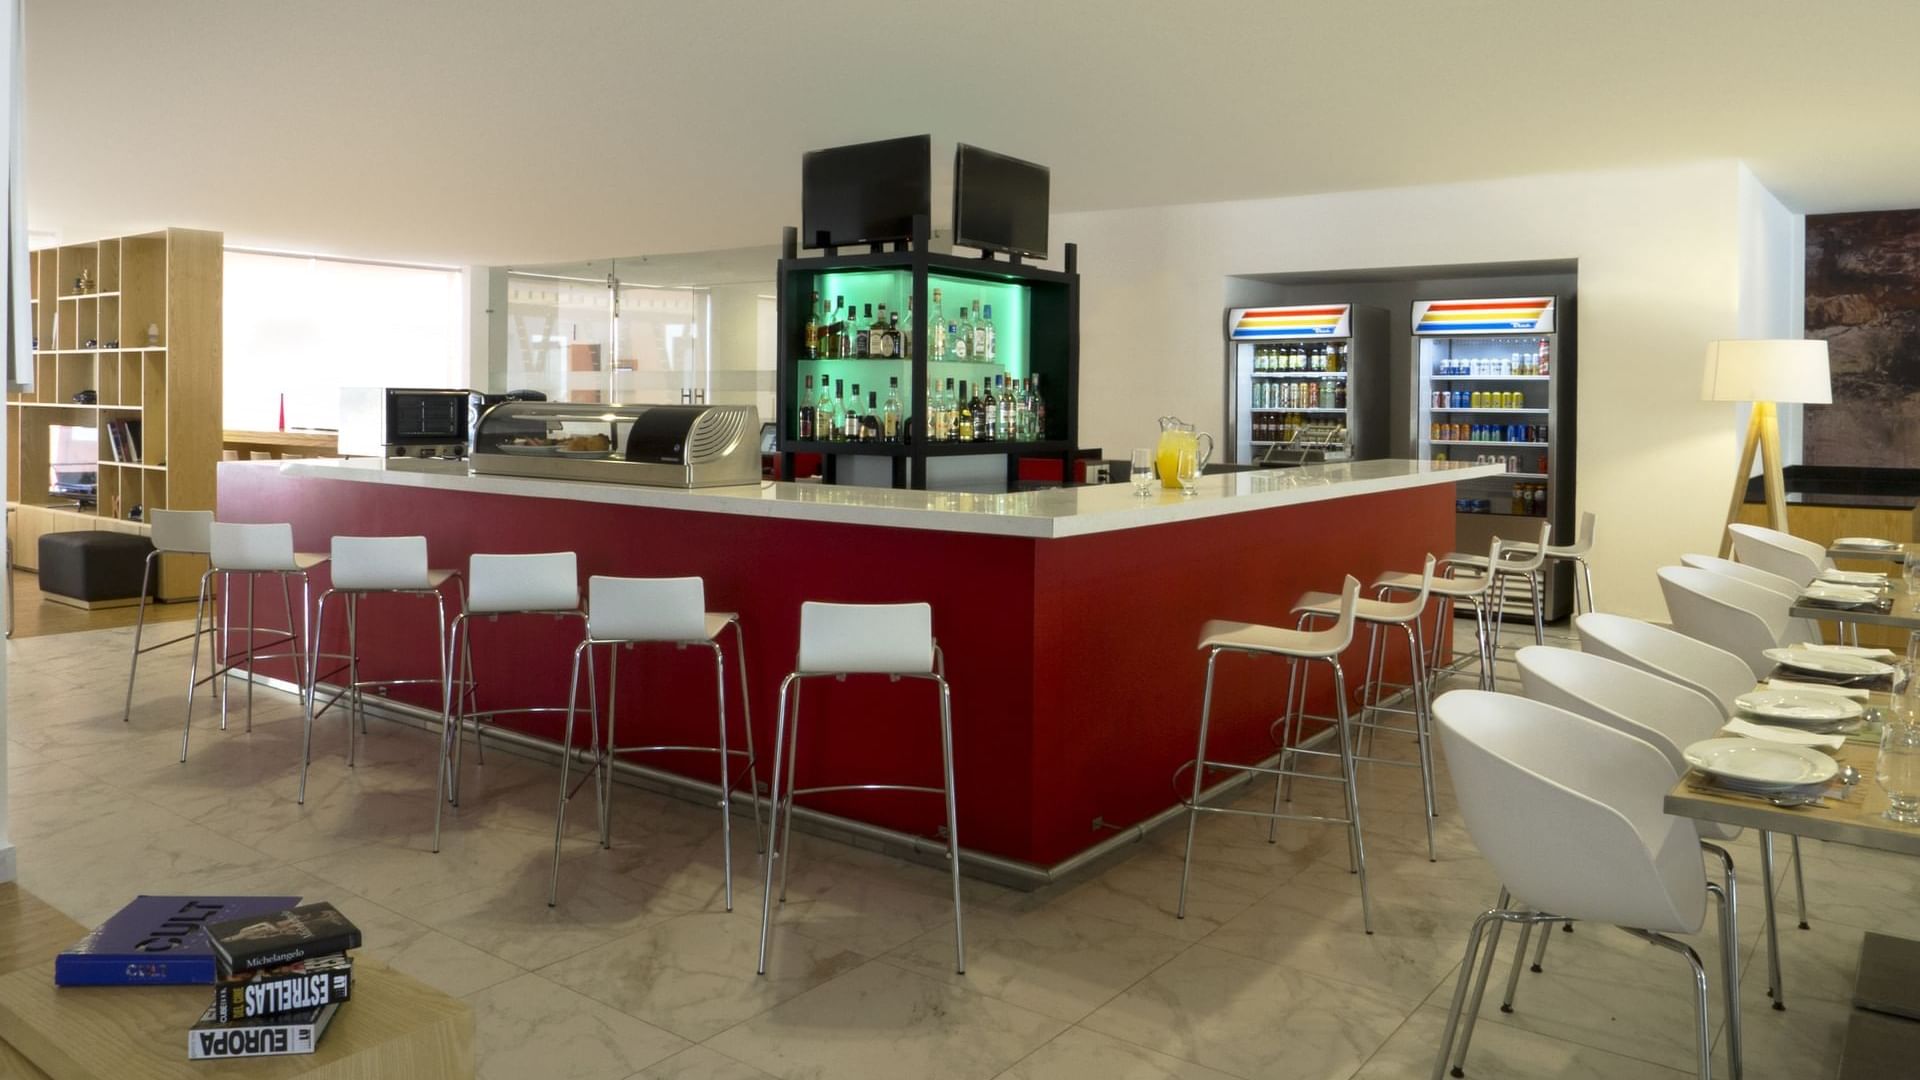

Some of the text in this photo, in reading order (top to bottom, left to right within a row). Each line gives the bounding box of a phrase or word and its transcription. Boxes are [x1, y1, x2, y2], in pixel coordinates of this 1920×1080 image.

[134, 901, 224, 952] CULT
[246, 948, 304, 968] Michelangelo
[245, 973, 329, 1017] ESTRELLAS
[200, 1028, 288, 1056] EUROPA
